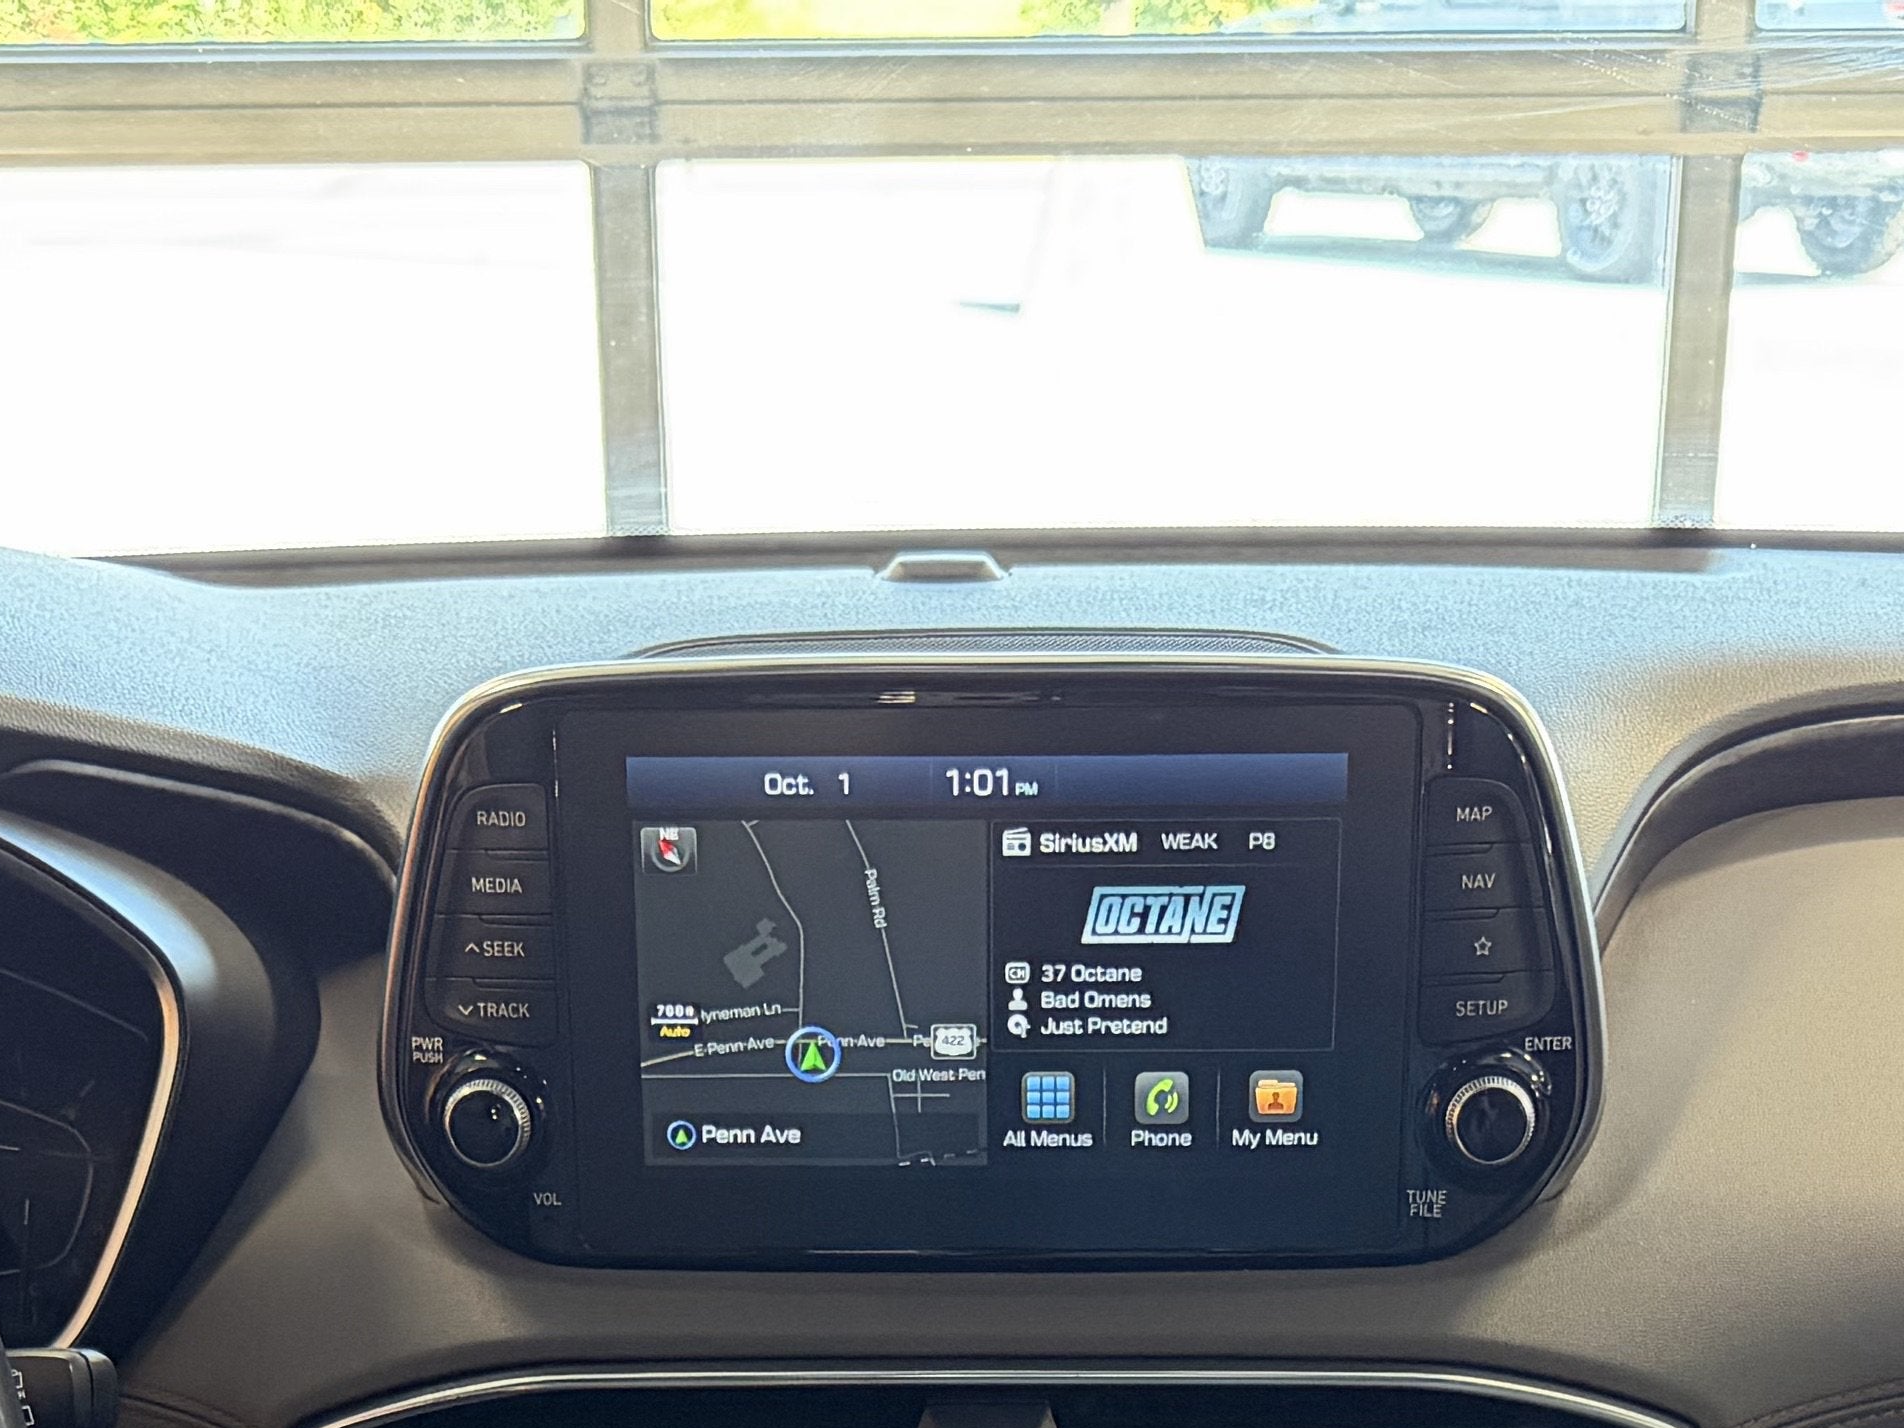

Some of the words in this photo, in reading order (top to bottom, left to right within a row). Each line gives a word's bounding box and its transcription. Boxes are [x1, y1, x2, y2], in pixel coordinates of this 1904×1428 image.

[763, 772, 815, 796] Oct.
[838, 773, 850, 796] 1
[946, 767, 1010, 797] 1:01
[1014, 781, 1038, 796] PM
[477, 811, 526, 827] RADIO
[1456, 806, 1493, 822] MAP
[1039, 832, 1138, 854] SiriusXM
[1161, 832, 1218, 850] WEAK
[1248, 832, 1276, 850] P8
[471, 877, 523, 893] MEDIA
[1461, 873, 1496, 890] NAV
[865, 867, 881, 908] Palm
[873, 907, 887, 930] Rd
[1091, 888, 1237, 938] OCTANE
[483, 941, 525, 957] SEEK
[1041, 965, 1066, 983] 37
[1070, 964, 1143, 983] Octane
[1040, 991, 1080, 1009] Bad
[1084, 991, 1152, 1009] Omens
[1456, 1000, 1508, 1017] SETUP
[477, 1002, 530, 1018] TRACK
[763, 1003, 782, 1016] Ln
[659, 1025, 692, 1038] Auto
[1040, 1017, 1084, 1035] Just
[1087, 1016, 1168, 1035] Pretend
[411, 1036, 443, 1051] PWR
[694, 1044, 705, 1057] E
[707, 1041, 744, 1056] Penn
[747, 1037, 775, 1051] Ave
[857, 1034, 886, 1047] Ave
[942, 1035, 965, 1047] 422
[1525, 1036, 1572, 1051] ENTER
[412, 1051, 443, 1063] PUSH
[892, 1068, 916, 1082] Old
[918, 1068, 955, 1082] West
[701, 1124, 756, 1144] Penn
[760, 1124, 802, 1144] Ave
[1003, 1129, 1028, 1148] All
[1030, 1129, 1094, 1148] Menus
[1130, 1129, 1193, 1148] Phone
[1232, 1128, 1260, 1149] My
[1265, 1128, 1318, 1146] Menu
[533, 1192, 562, 1206] VOL
[1406, 1189, 1447, 1205] TUNE
[1409, 1203, 1443, 1218] FILE
